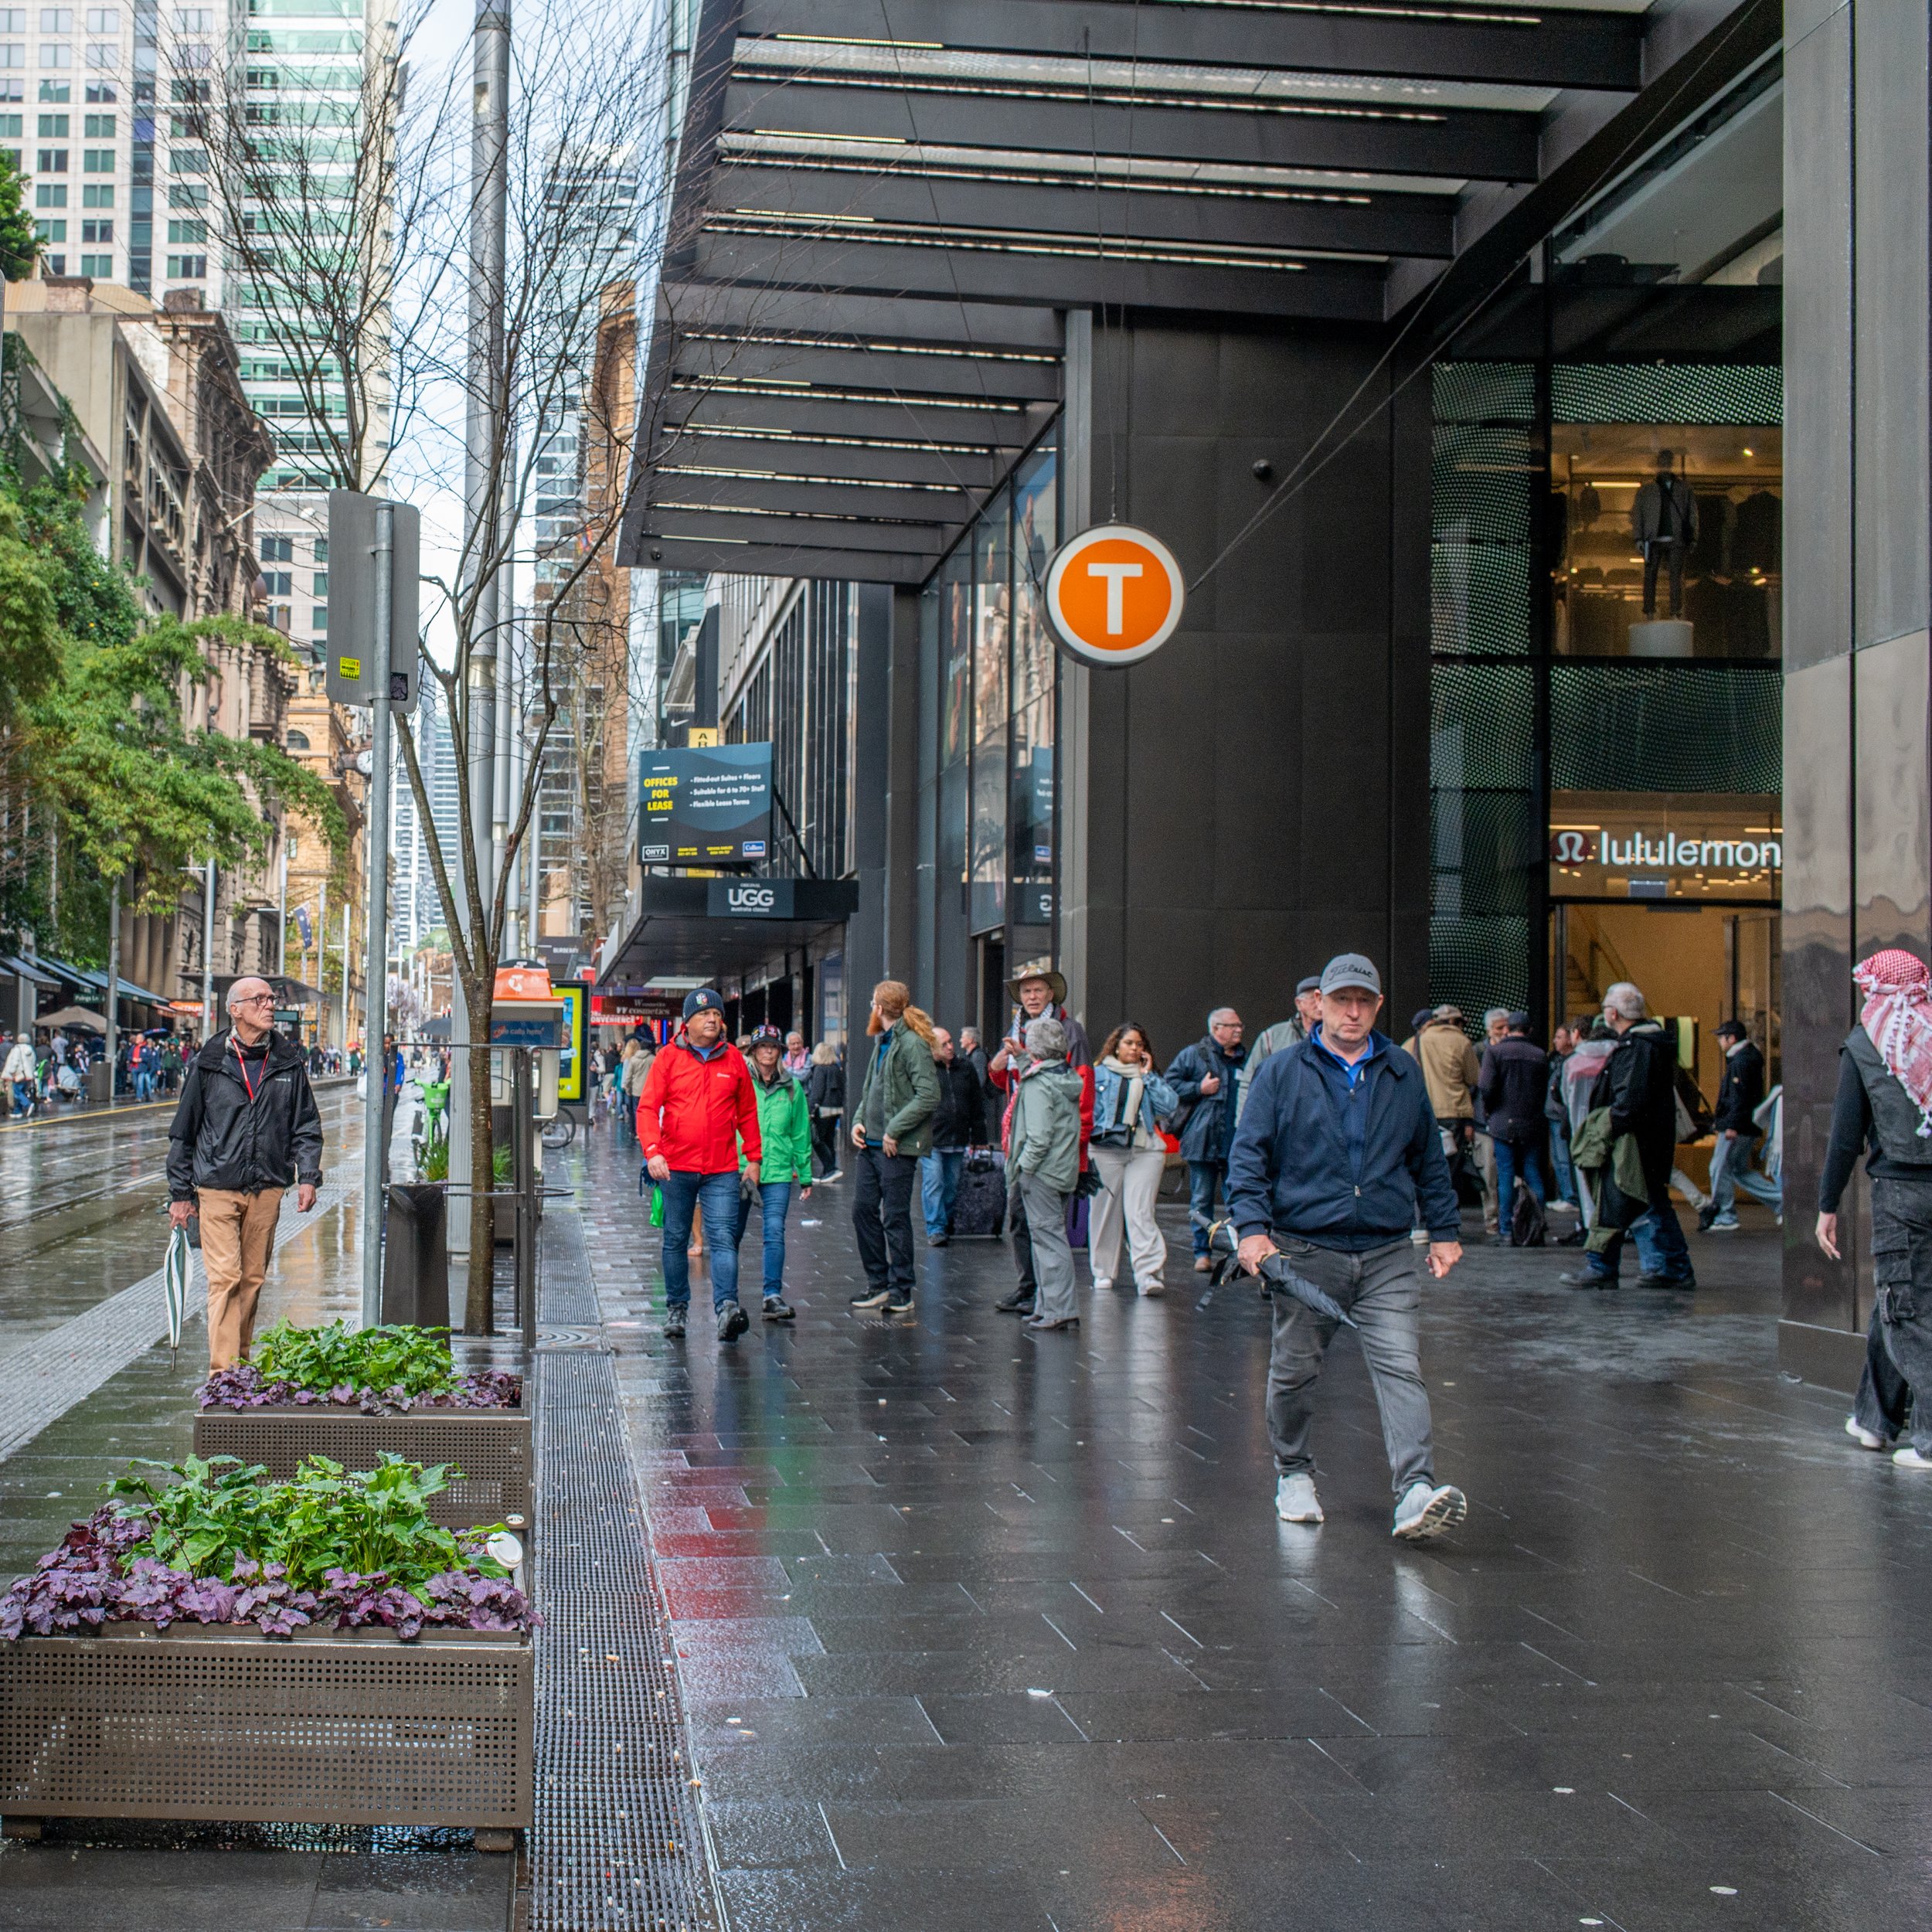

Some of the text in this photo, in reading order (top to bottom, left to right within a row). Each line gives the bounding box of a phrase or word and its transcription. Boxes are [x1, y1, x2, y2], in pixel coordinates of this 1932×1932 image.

[1087, 563, 1144, 635] T
[644, 777, 678, 787] OFFICES
[751, 784, 765, 793] Staff
[651, 789, 669, 799] FOR
[647, 801, 673, 811] LEASE
[1600, 831, 1781, 867] lululemon
[728, 889, 774, 906] UGG
[1328, 964, 1373, 981] Titleist
[590, 1014, 635, 1024] ONVENIENCE
